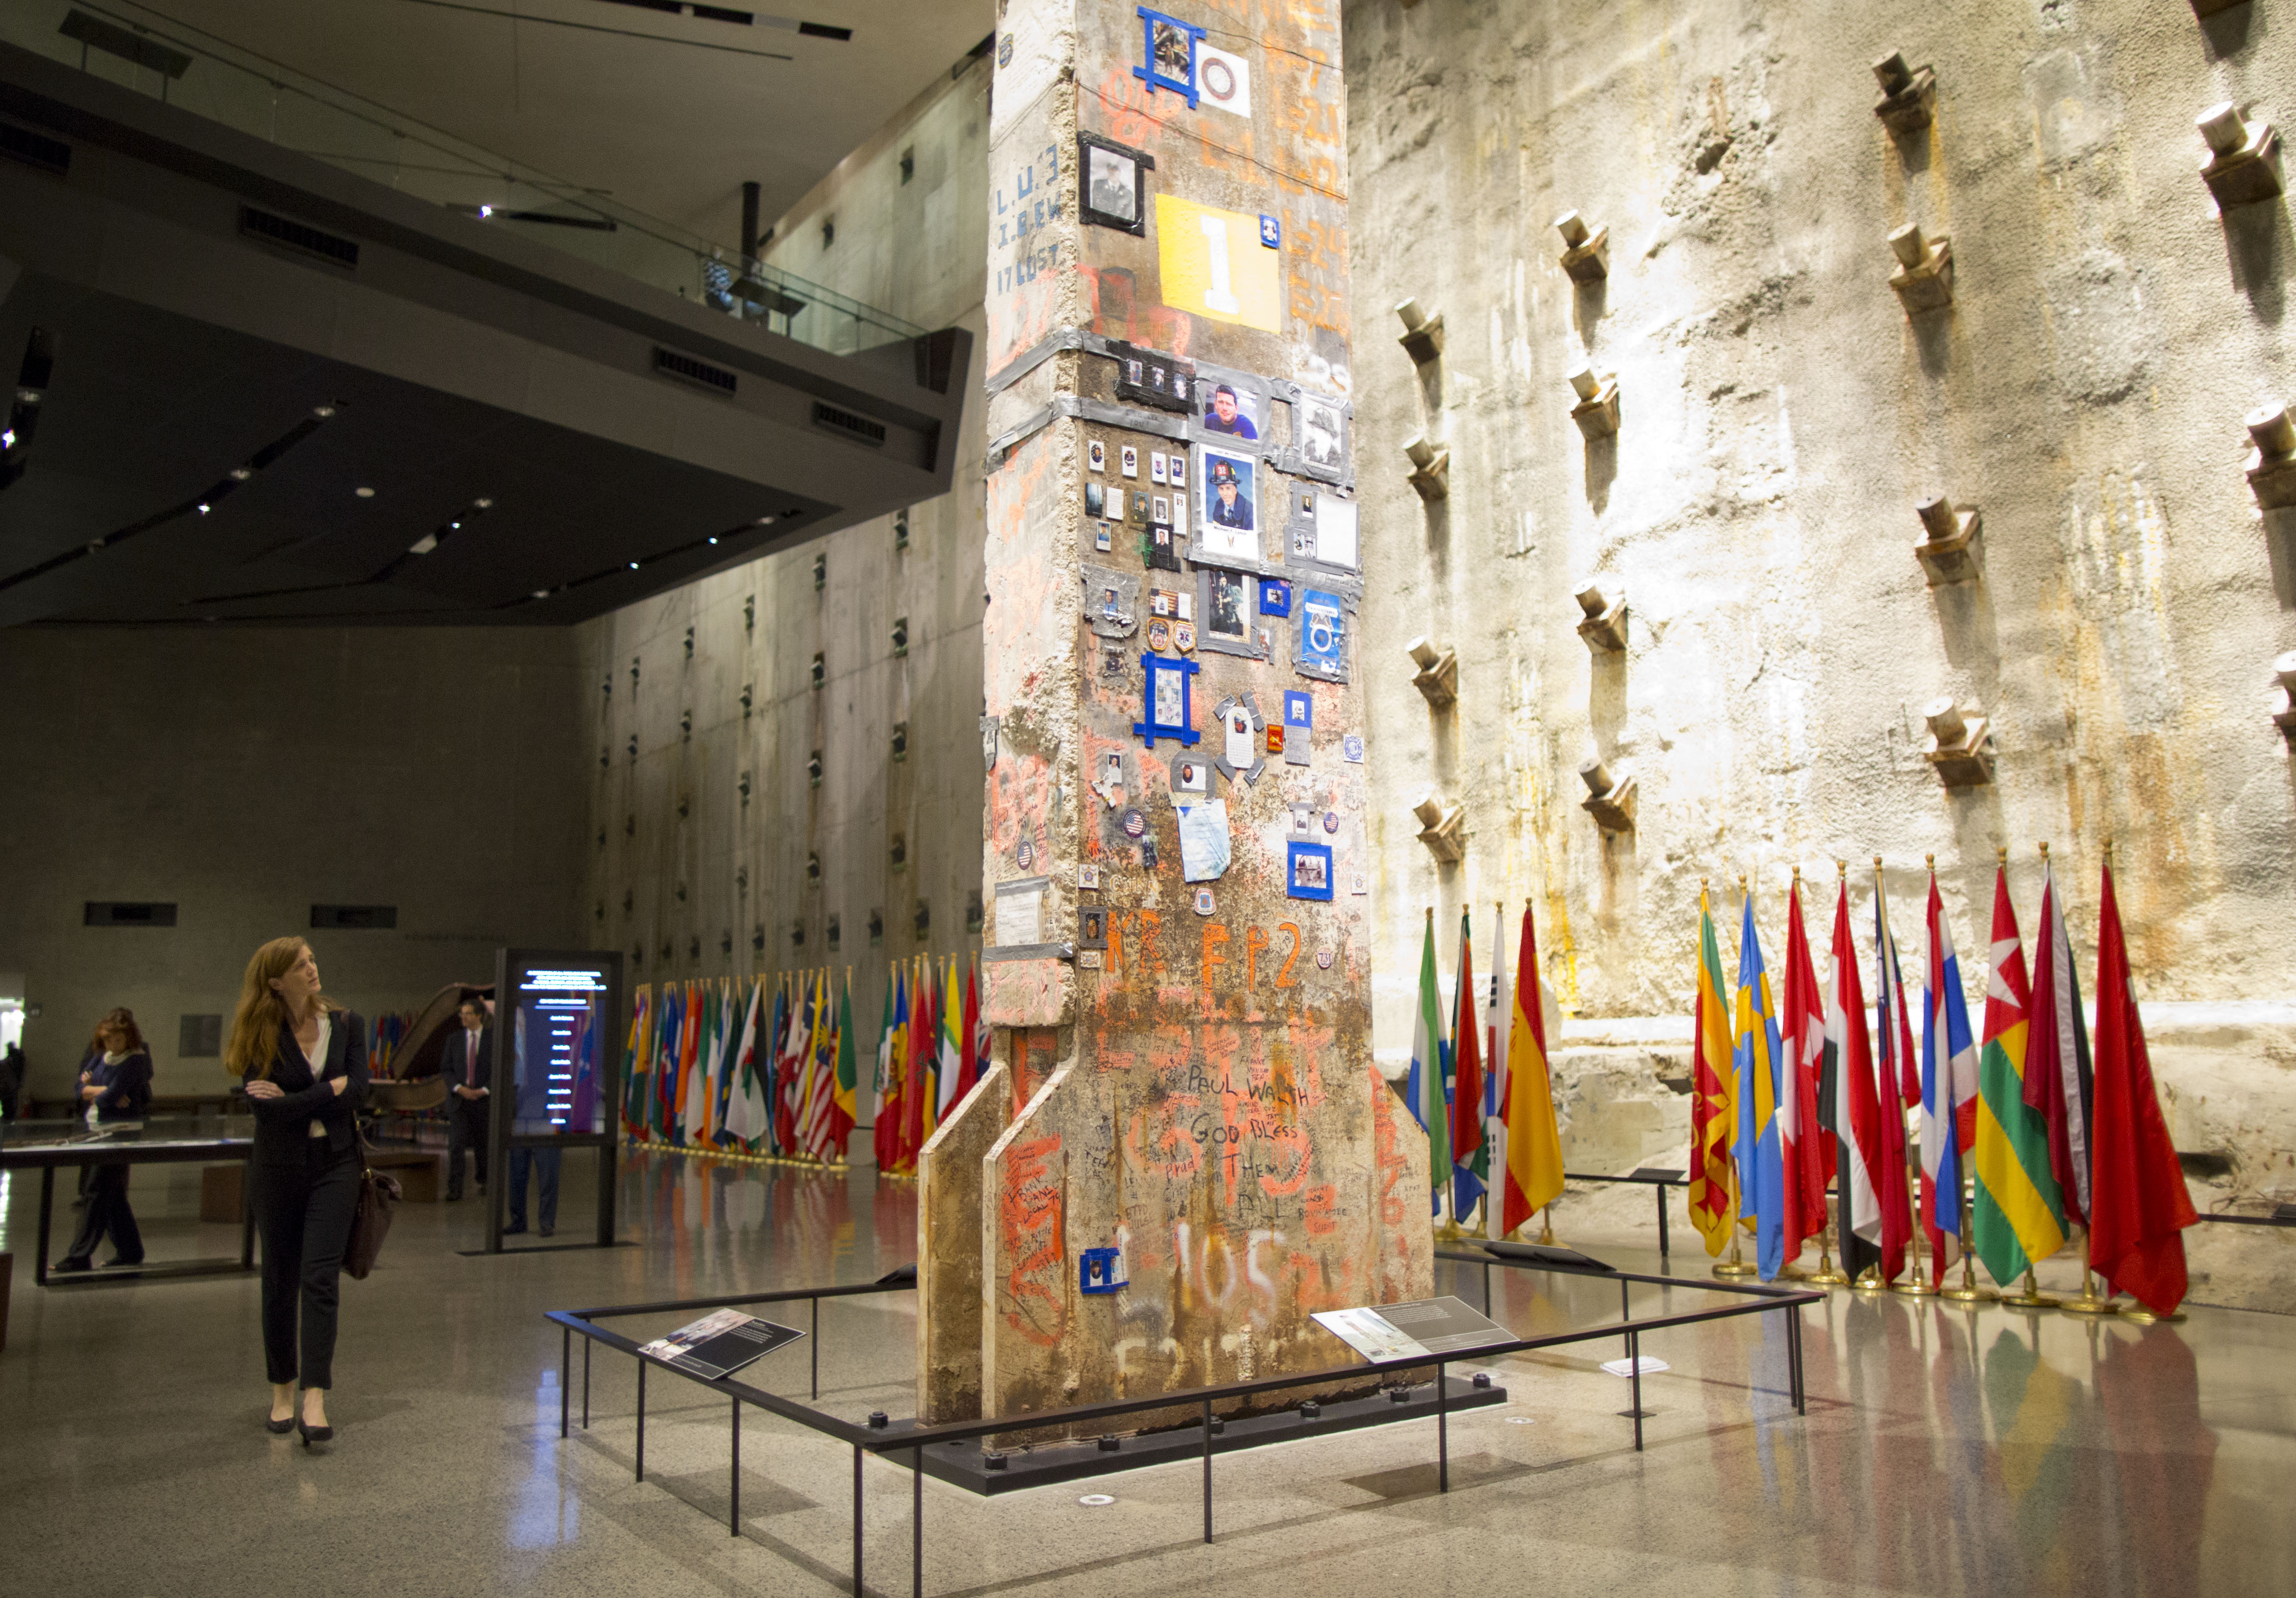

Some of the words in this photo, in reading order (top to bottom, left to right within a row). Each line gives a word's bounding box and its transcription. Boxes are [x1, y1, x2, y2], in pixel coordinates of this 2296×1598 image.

[1217, 466, 1227, 474] 32
[1317, 952, 1332, 963] 731
[1188, 1064, 1238, 1096] PAUL
[1191, 1112, 1240, 1144] GOD
[1251, 1118, 1298, 1141] BLESS
[1238, 1193, 1290, 1220] ALL
